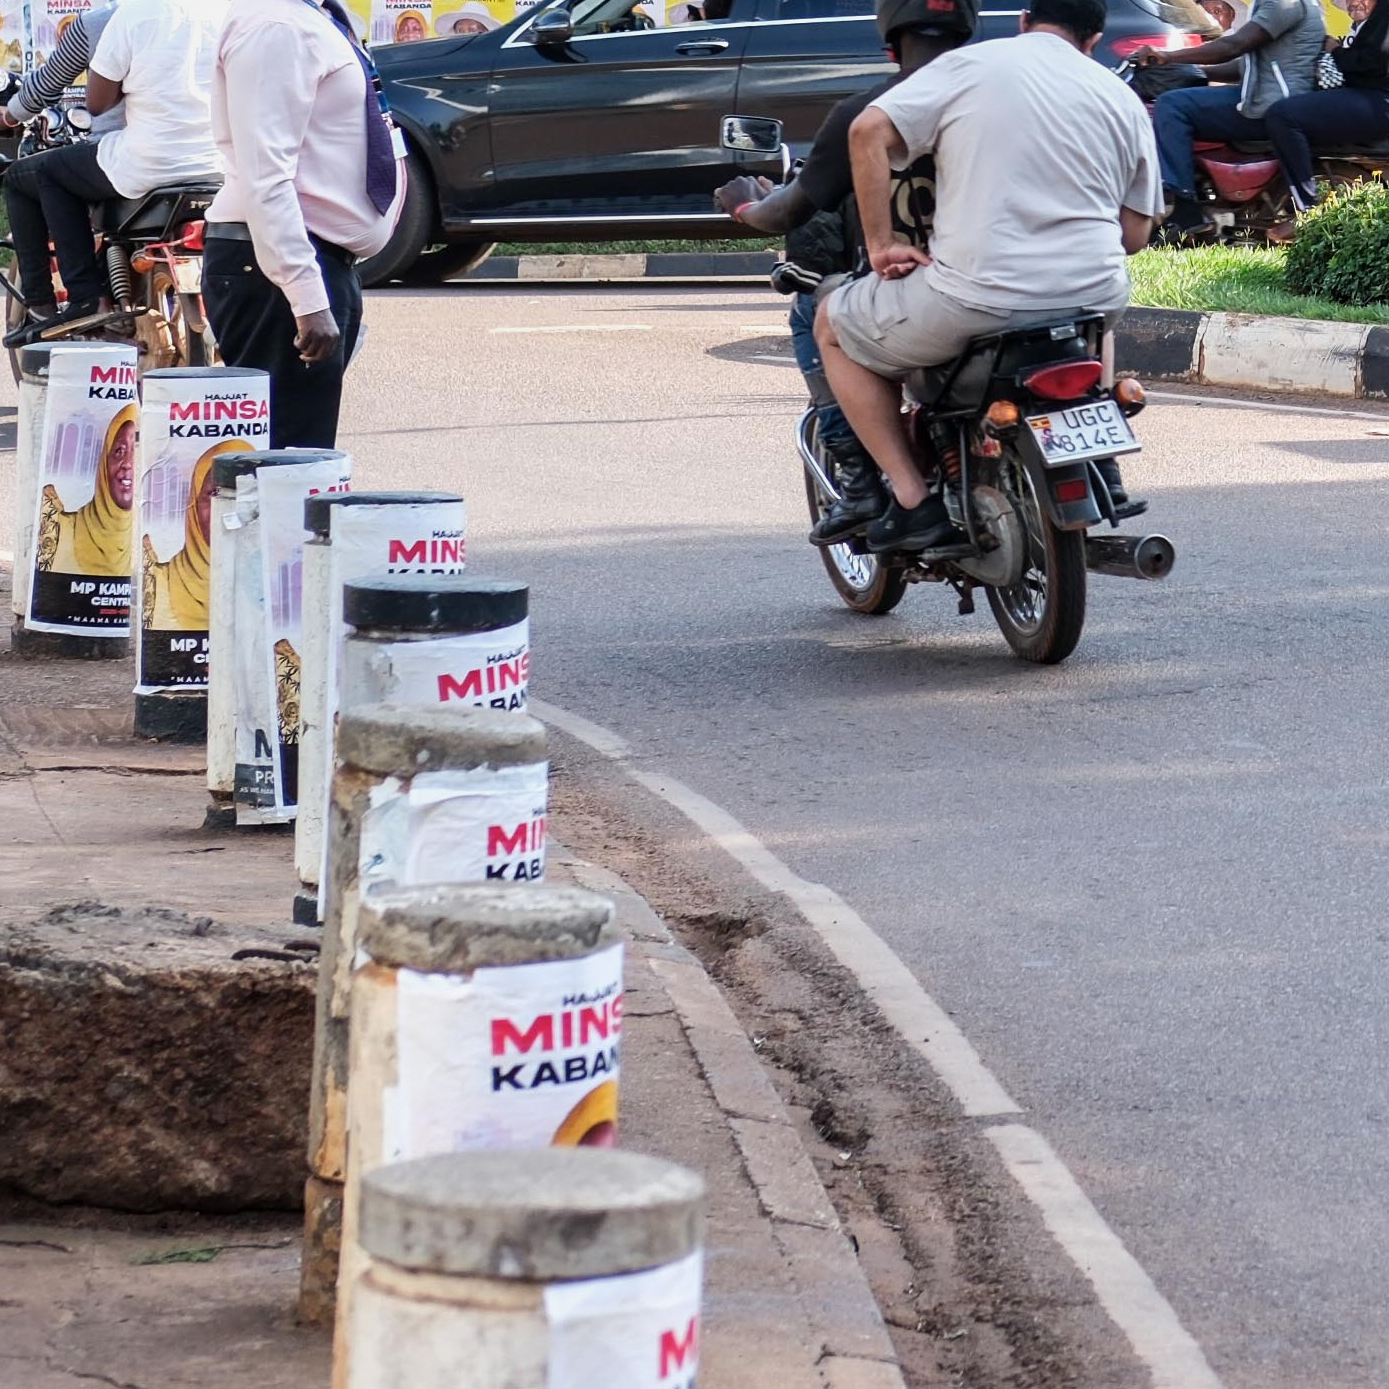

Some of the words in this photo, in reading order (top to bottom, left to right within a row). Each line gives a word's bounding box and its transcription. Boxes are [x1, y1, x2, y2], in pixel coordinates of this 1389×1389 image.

[47, 0, 91, 8] MINSA
[91, 366, 136, 385] MIN
[89, 386, 136, 400] KABA
[170, 401, 268, 421] MINSA
[1062, 405, 1112, 429] UGC
[169, 424, 268, 438] KABANDA
[1061, 427, 1125, 452] 814E
[389, 540, 466, 563] MINS
[70, 581, 96, 594] MP
[99, 583, 131, 595] KAMP
[171, 639, 197, 652] MP
[438, 652, 531, 702] MINS
[490, 992, 622, 1056] MINS
